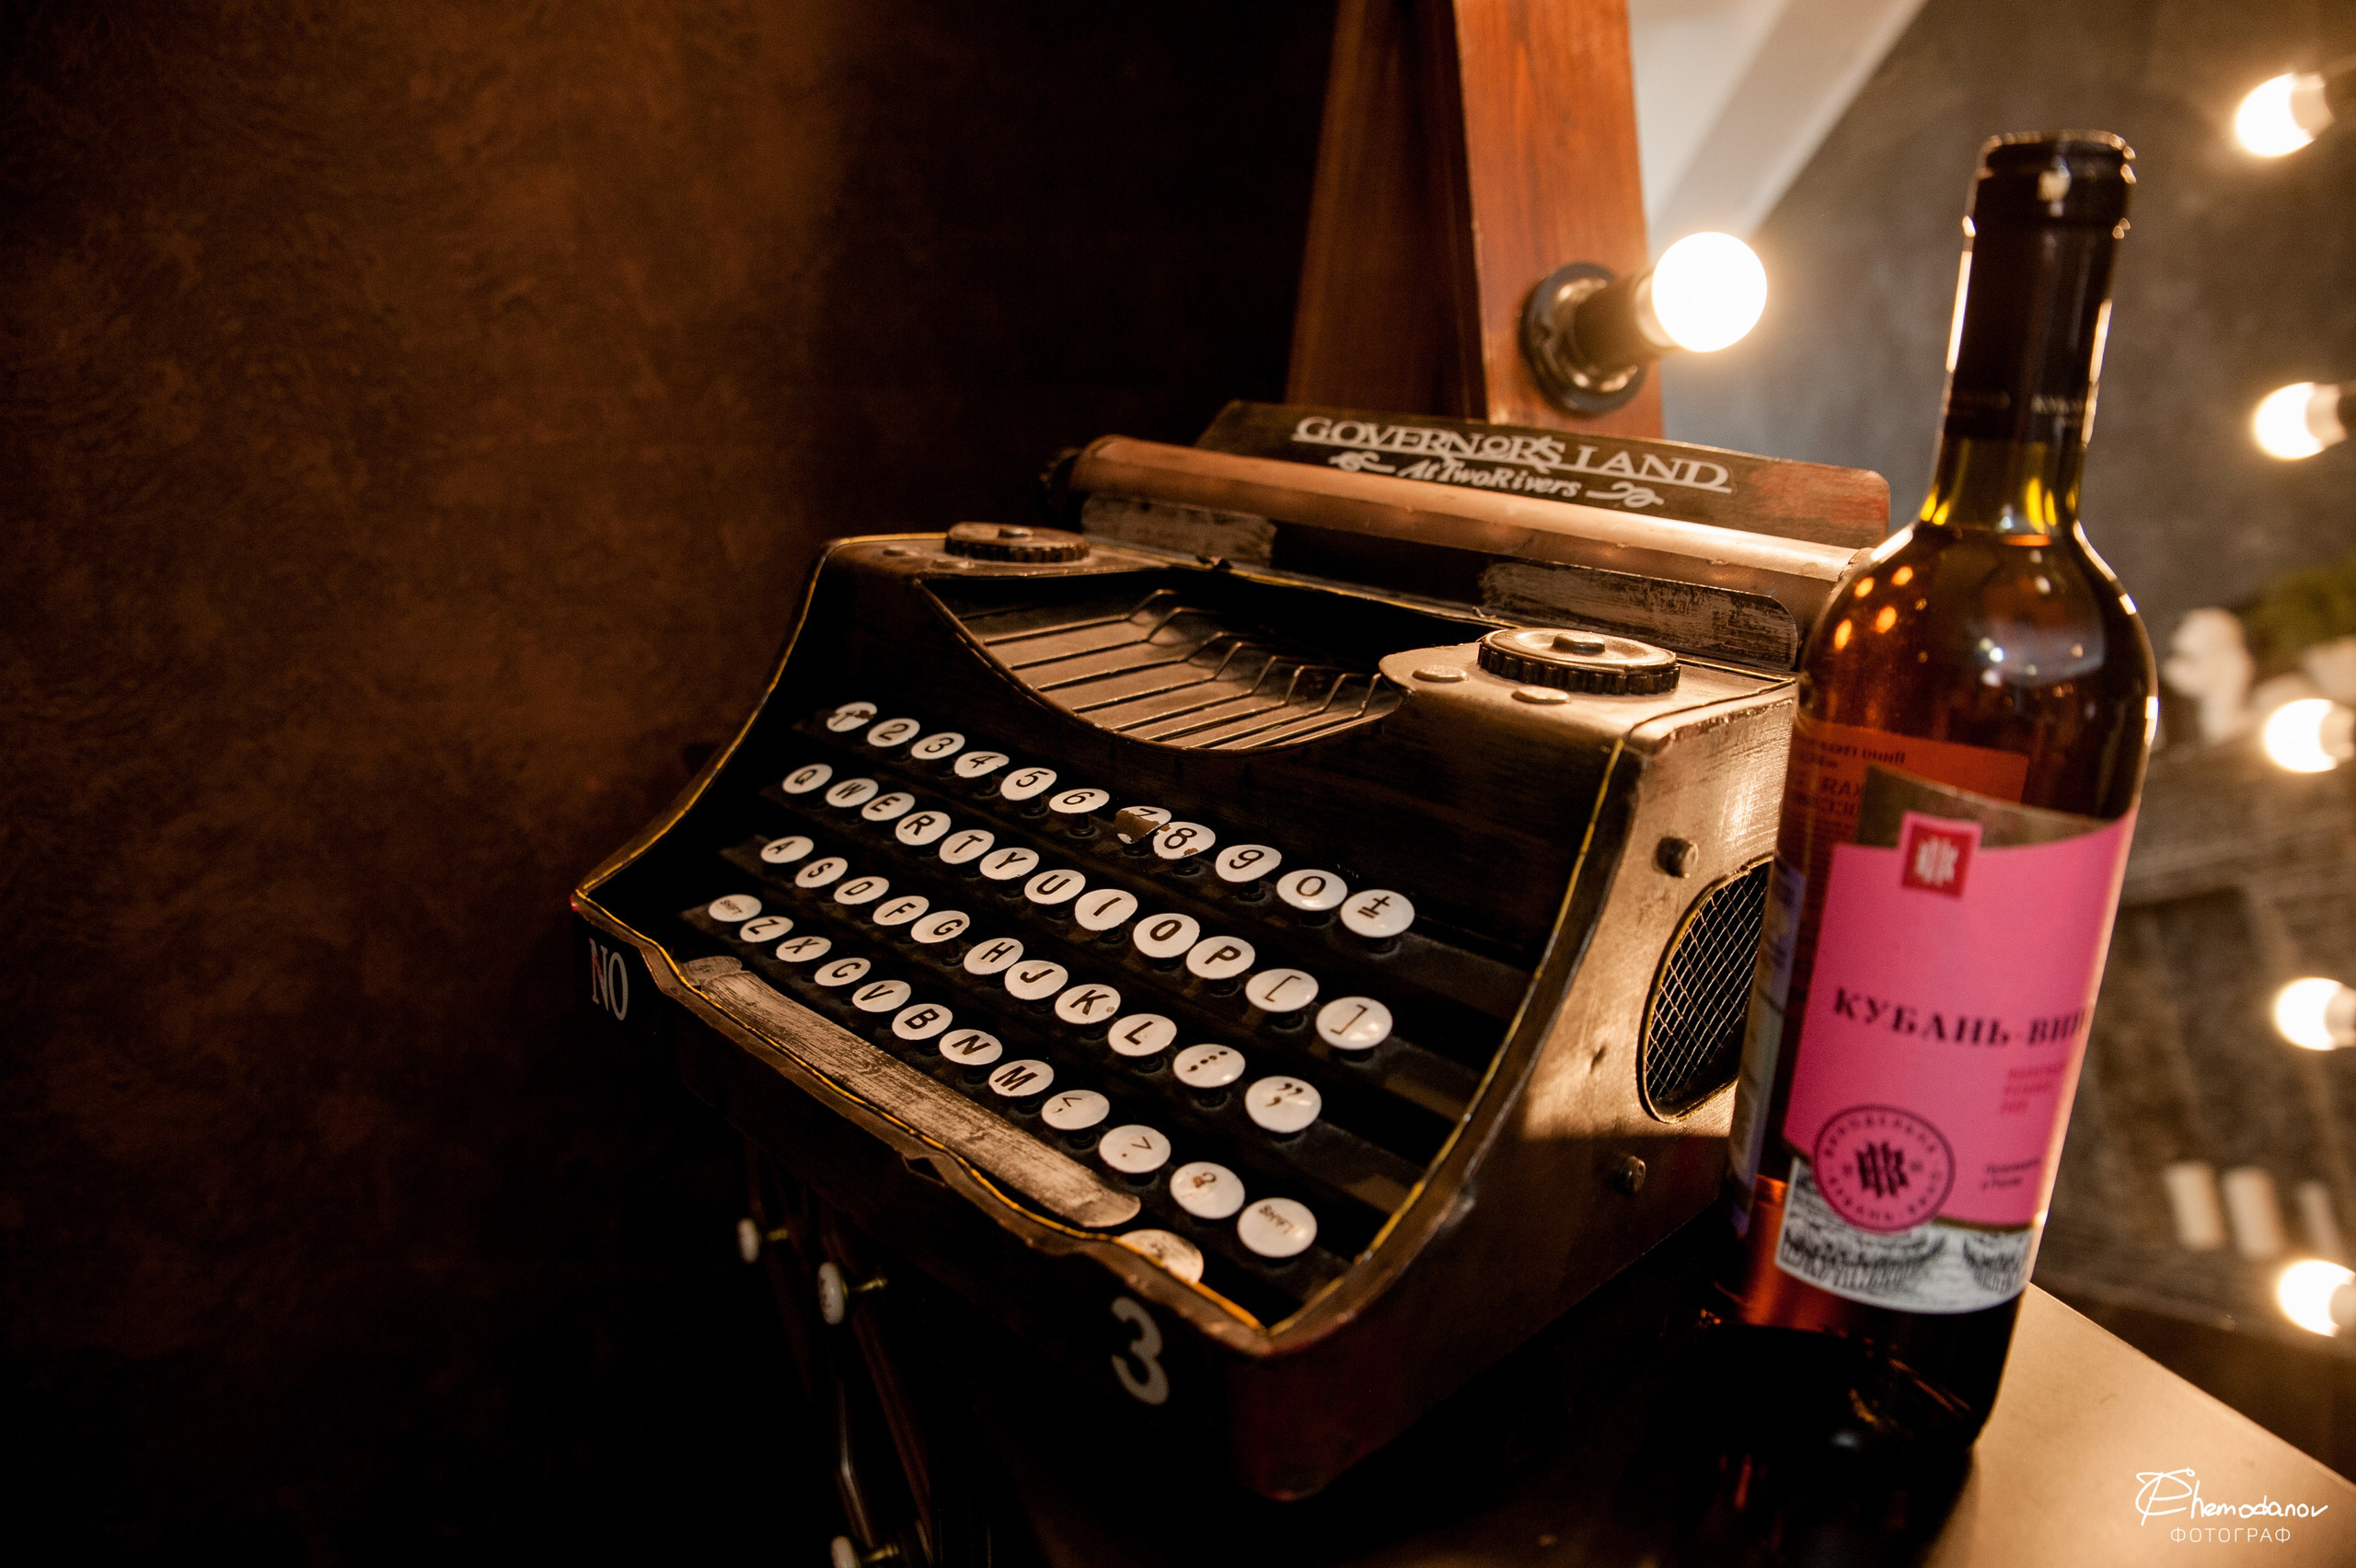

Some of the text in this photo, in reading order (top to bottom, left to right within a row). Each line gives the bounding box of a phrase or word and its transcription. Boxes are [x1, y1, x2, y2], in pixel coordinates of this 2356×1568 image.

[1576, 445, 1732, 493] LAND
[794, 769, 817, 785] Q
[838, 783, 866, 799] W
[870, 796, 901, 812] E
[904, 814, 935, 836] R
[953, 835, 984, 853] T
[995, 852, 1028, 870] Y
[1036, 877, 1070, 894] U
[1205, 945, 1242, 964] P
[878, 723, 909, 741] 2
[925, 737, 954, 753] 3
[970, 755, 999, 768] 4
[1016, 771, 1049, 788] 5
[1062, 791, 1094, 805] 6
[1164, 828, 1197, 849] 8
[1230, 849, 1265, 870] 9
[589, 938, 629, 1020] NO
[748, 919, 780, 935] Z
[785, 939, 814, 953] X
[832, 963, 861, 978] C
[860, 985, 894, 1001] V
[904, 1009, 940, 1030] B
[952, 1034, 991, 1055] N
[995, 1066, 1038, 1091] M
[768, 841, 794, 854] A
[807, 862, 833, 878] S
[844, 882, 873, 895] D
[884, 903, 916, 917] F
[933, 919, 963, 935] G
[980, 942, 1015, 963] H
[1020, 969, 1055, 983] J
[1069, 989, 1106, 1015] K
[1124, 1021, 1153, 1045] L
[1111, 1296, 1169, 1405] 3
